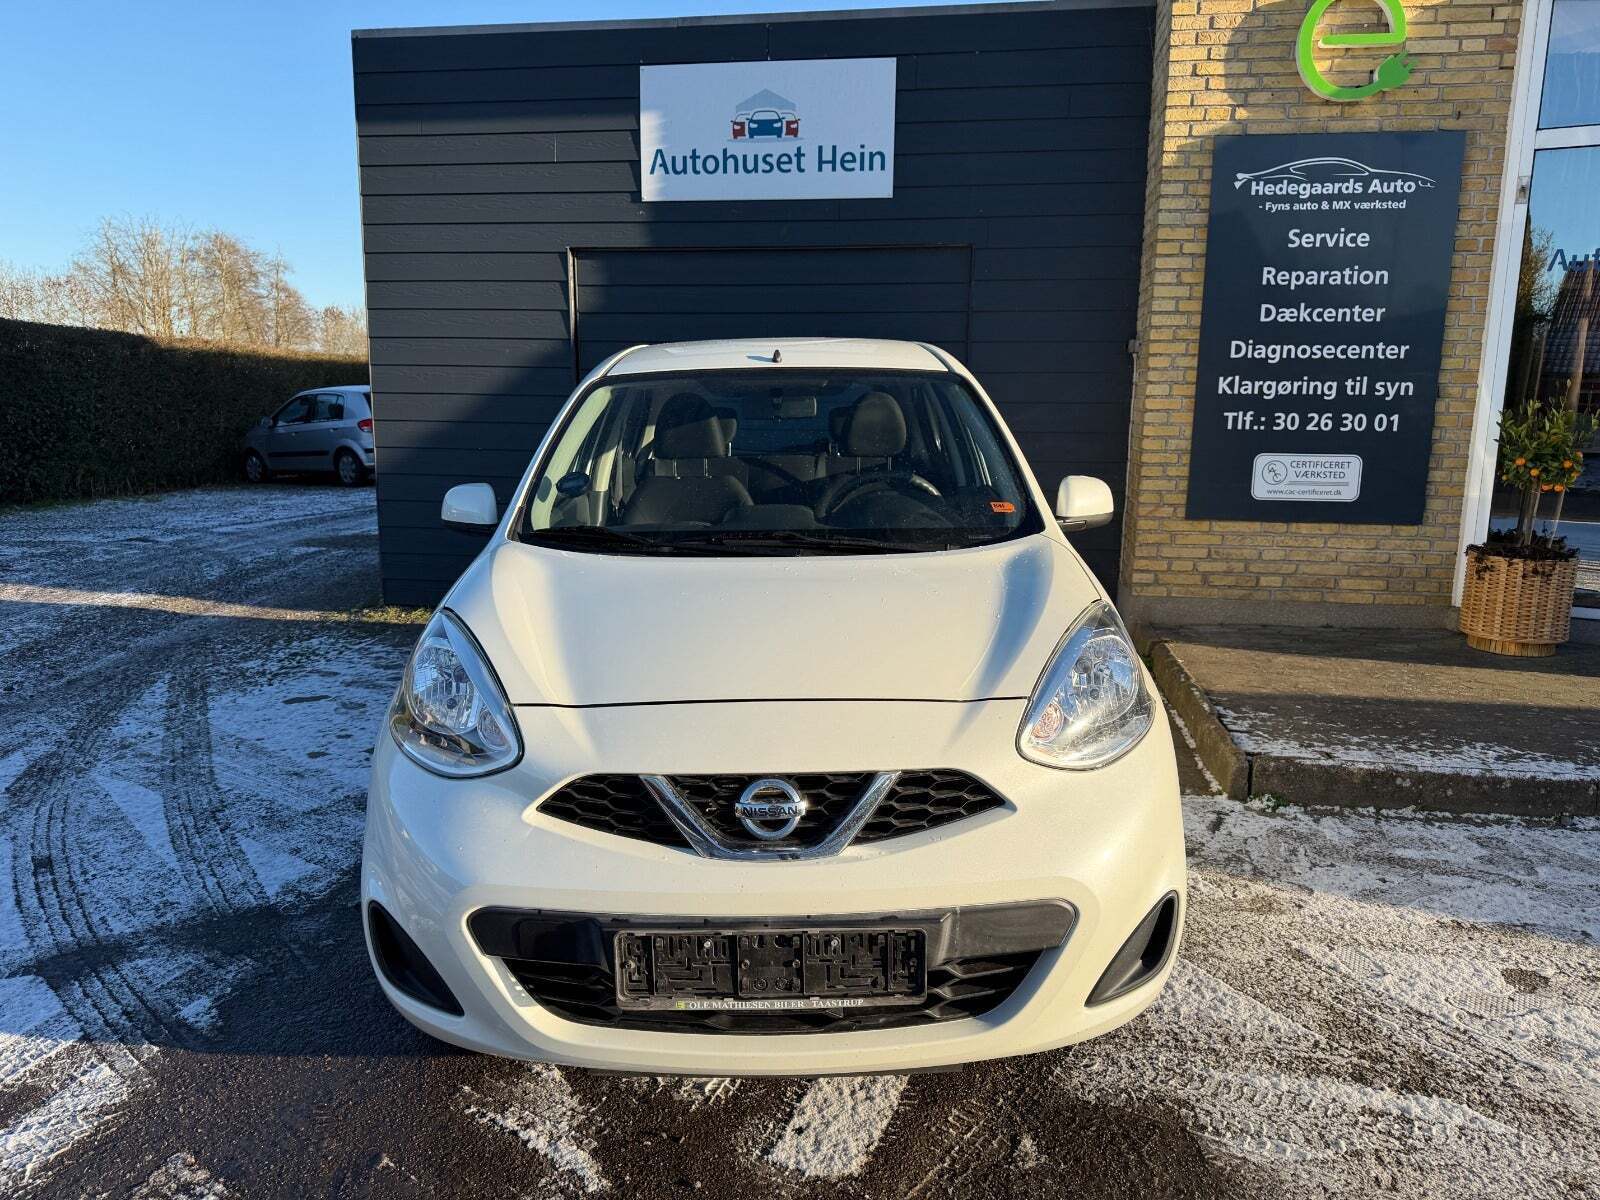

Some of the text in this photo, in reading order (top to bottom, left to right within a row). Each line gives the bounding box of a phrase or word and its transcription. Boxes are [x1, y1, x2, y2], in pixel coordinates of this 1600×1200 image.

[650, 145, 886, 175] Autohuset Hein
[1250, 179, 1416, 198] Hedegaards Auto
[1265, 202, 1290, 213] Fyns
[1293, 201, 1318, 210] auto
[1321, 201, 1329, 210] &
[1332, 200, 1351, 210] MX
[1354, 199, 1406, 210] værksted
[1287, 227, 1370, 248] Service
[1262, 265, 1389, 289] Reparation
[1260, 302, 1386, 322] Dækcenter
[1230, 340, 1409, 363] Diagnosecenter
[1217, 376, 1414, 400] Klargøring til syn
[1224, 412, 1400, 431] Tlf.: 30 26 30 01
[1290, 460, 1352, 469] CERTIFICERET
[1294, 470, 1346, 479] VÆRKSTED
[743, 805, 798, 818] NISSAN
[812, 999, 864, 1008] TAASTRUP
